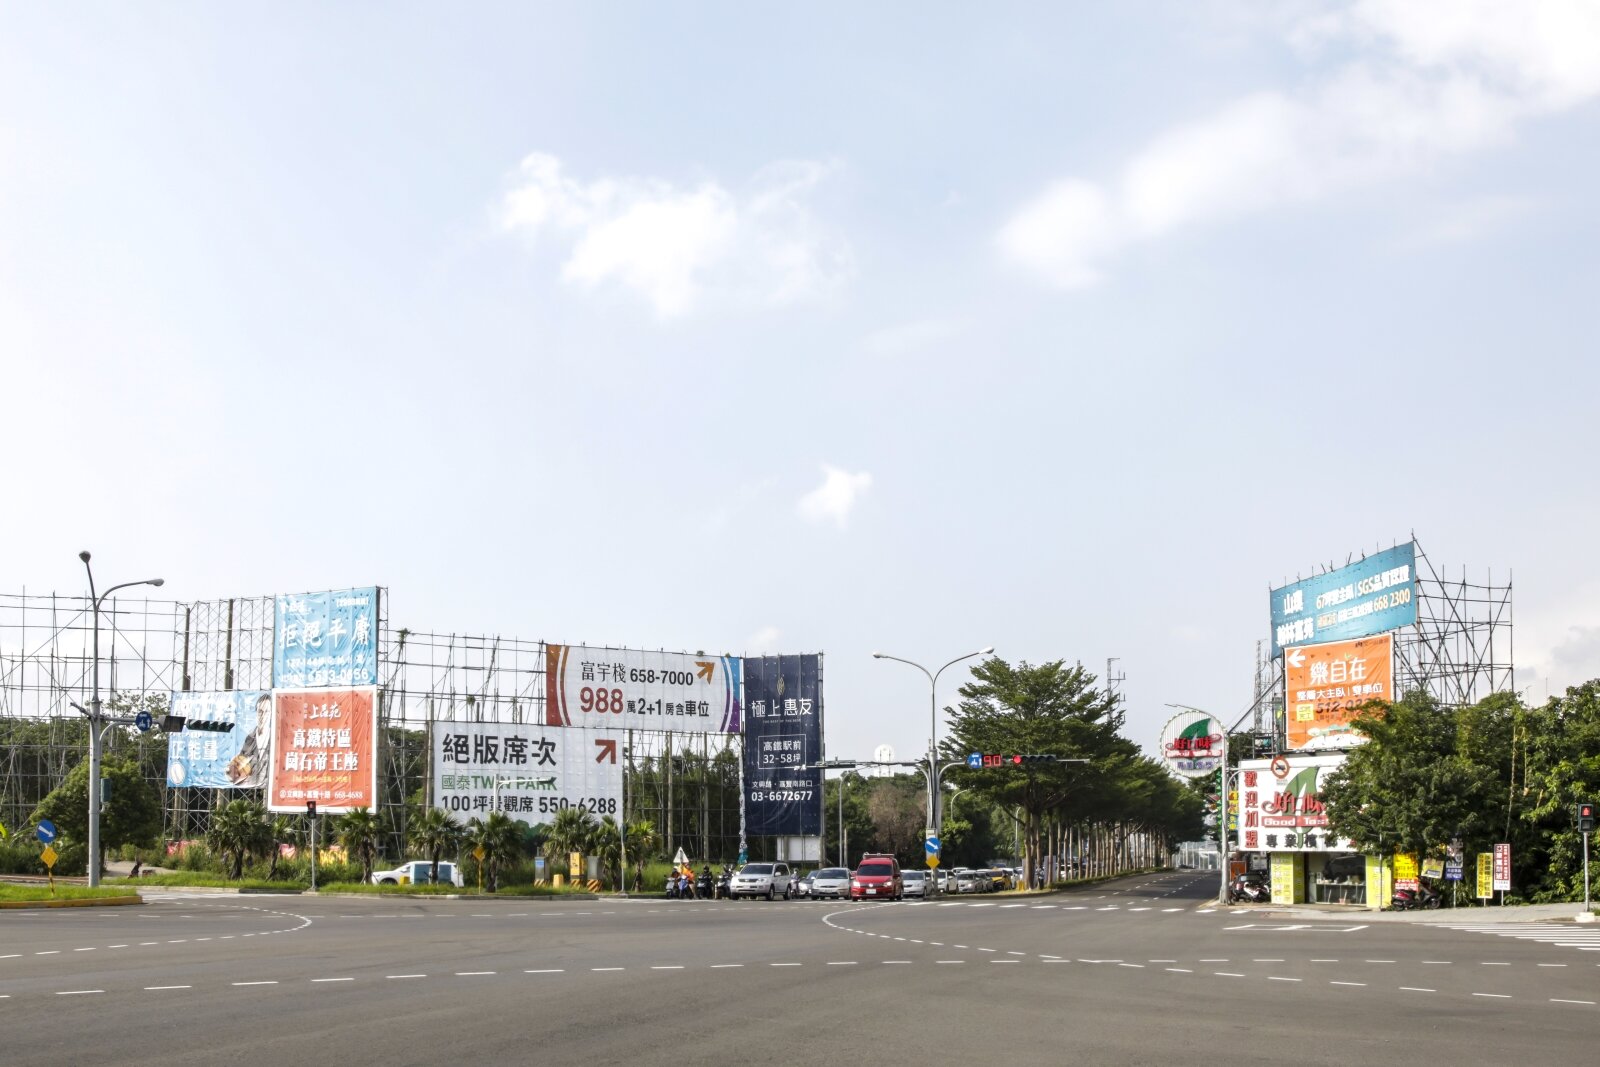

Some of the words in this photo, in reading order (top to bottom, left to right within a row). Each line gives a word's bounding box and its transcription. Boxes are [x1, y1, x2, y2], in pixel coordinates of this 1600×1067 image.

[1374, 595, 1388, 611] 668
[1390, 588, 1410, 607] 2300
[581, 661, 626, 683] 富宇棧
[630, 669, 693, 685] 658-7000
[1310, 657, 1367, 685] 樂自在
[752, 698, 813, 717] 極上惠友
[293, 728, 351, 748] 高鐵特區
[172, 740, 217, 760] 正能量
[442, 734, 557, 766] 絕版席次
[442, 774, 511, 790] 國泰TWN
[539, 797, 616, 814] 550-6288
[751, 791, 813, 801] 03-6672677
[1244, 771, 1258, 848] 歡迎加盟
[1264, 818, 1295, 826] Good
